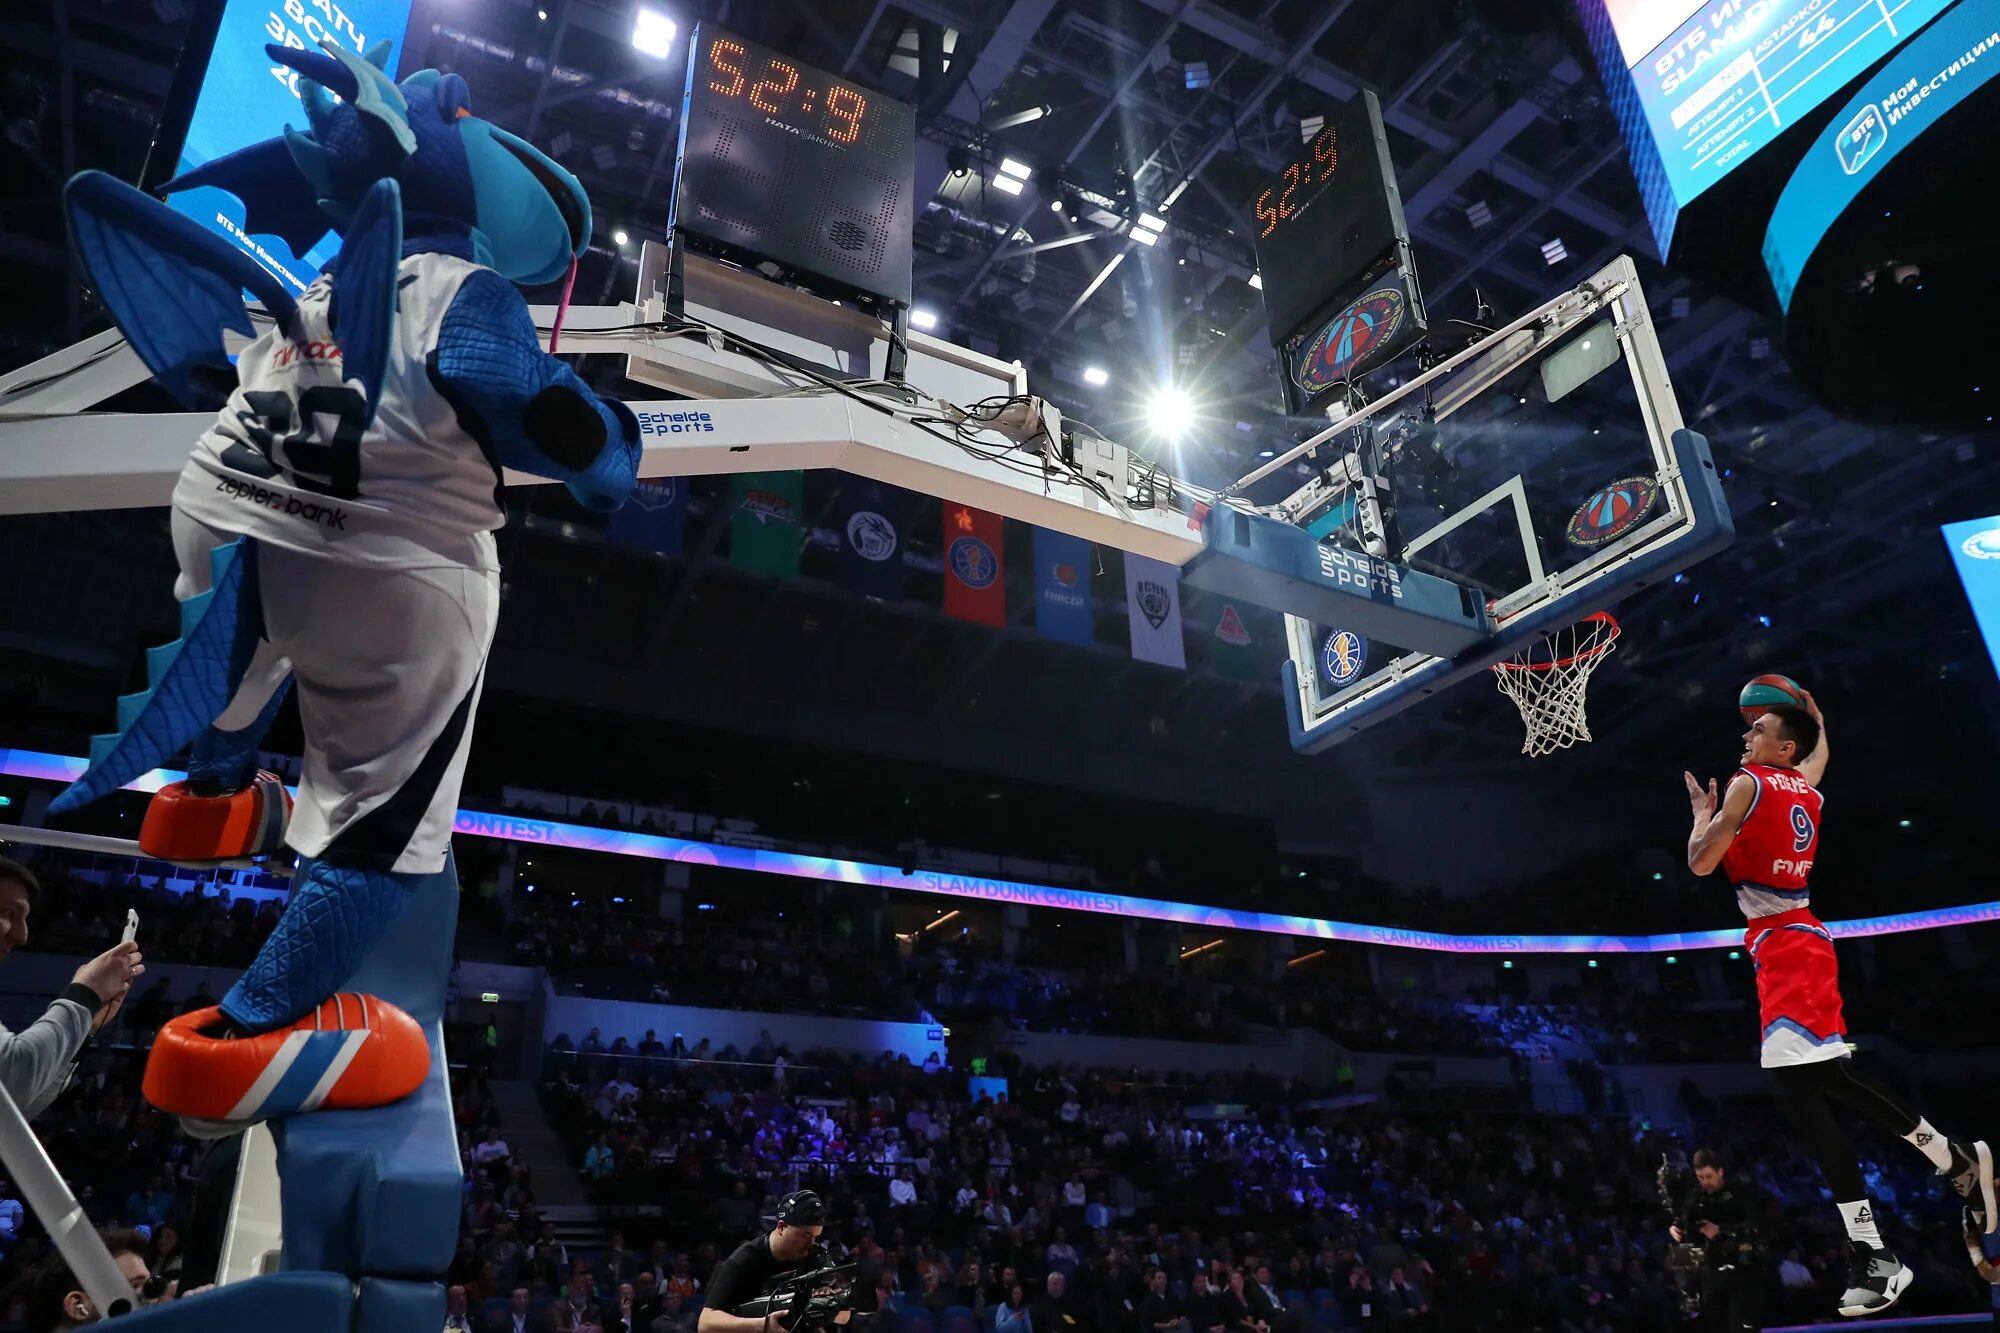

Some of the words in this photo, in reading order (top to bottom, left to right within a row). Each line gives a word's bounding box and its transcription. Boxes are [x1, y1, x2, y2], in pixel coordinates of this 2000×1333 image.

[1655, 24, 1708, 77] ВТБ
[1798, 14, 1837, 49] 44
[710, 38, 867, 143] 52:9
[1687, 92, 1738, 137] ATTEMPT
[1851, 114, 1876, 144] ВТБ
[1881, 77, 1919, 113] Мои
[1697, 111, 1749, 157] ATTEMPT
[1715, 139, 1753, 168] TOTAL
[216, 212, 236, 233] ВТБ
[235, 227, 256, 251] Мои
[256, 244, 308, 293] Инвестиции
[638, 411, 712, 423] Schelde
[641, 422, 714, 437] Sports
[284, 494, 348, 531] bank
[1317, 545, 1400, 583] Schelde
[1320, 560, 1403, 599] Sports
[455, 814, 554, 841] ONTEST
[1790, 804, 1815, 853] 9
[924, 873, 980, 896] SLAM
[985, 881, 1039, 901] DUNK
[1043, 889, 1125, 912] CONTEST
[1373, 928, 1411, 944] SLAM
[1414, 934, 1451, 950] DUNK
[1450, 937, 1523, 950] CONTEST
[1854, 1216, 1873, 1224] PEA
